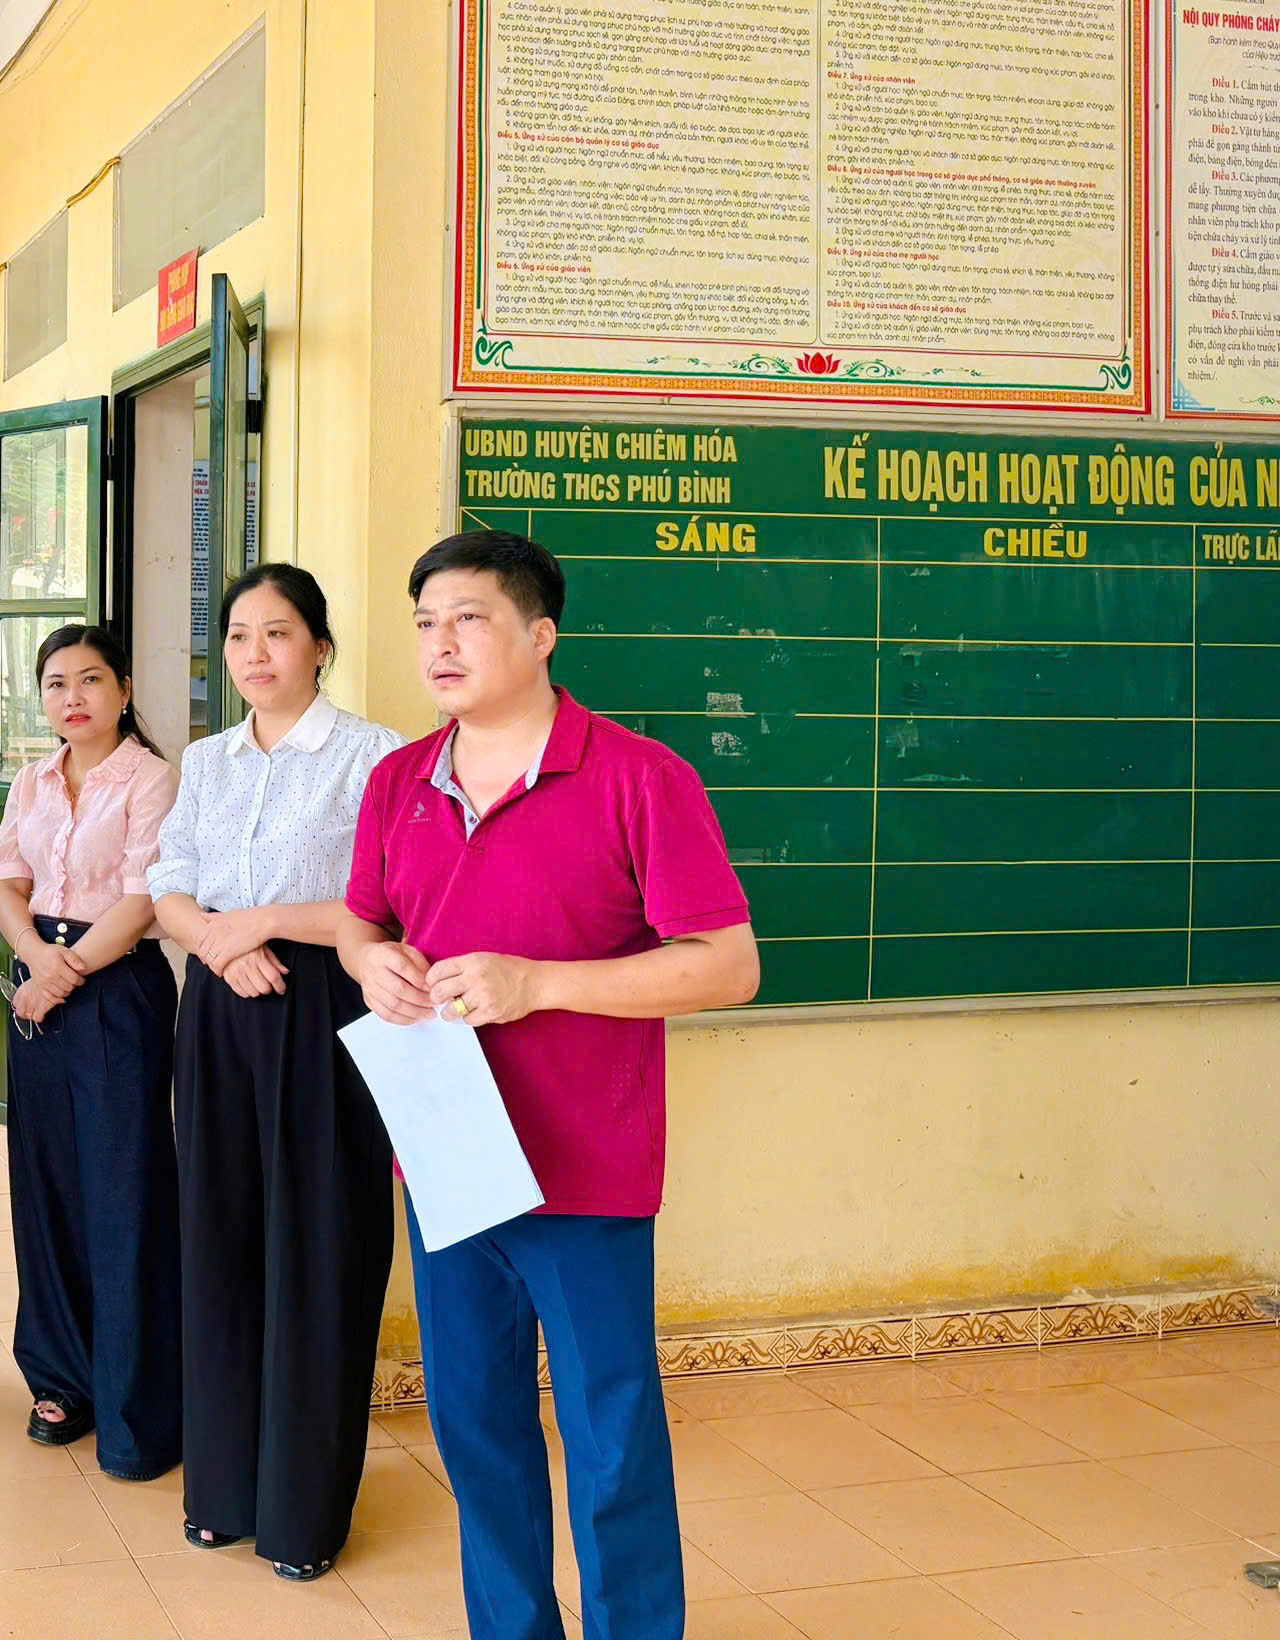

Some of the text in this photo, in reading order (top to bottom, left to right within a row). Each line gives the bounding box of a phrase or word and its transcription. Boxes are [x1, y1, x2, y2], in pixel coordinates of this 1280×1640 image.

[1183, 8, 1199, 28] NỘI
[1202, 11, 1220, 27] QUY
[1223, 11, 1253, 29] PHÒNG
[1212, 76, 1272, 91] Điều 1. Cấm hút
[1212, 122, 1229, 134] Điều
[1232, 126, 1238, 135] 2.
[1239, 127, 1252, 137] Vật
[464, 425, 738, 464] UBND HUYỆN CHIÊM HÓA
[465, 463, 731, 504] TRƯỜNG THCS PHÚ BÌNH
[823, 432, 1280, 515] KẾ HOẠCH HOẠT ĐỘNG CỦA N
[655, 514, 756, 553] SÁNG
[983, 521, 1088, 558] CHIỀU
[1202, 529, 1280, 565] TRỰC LÃ
